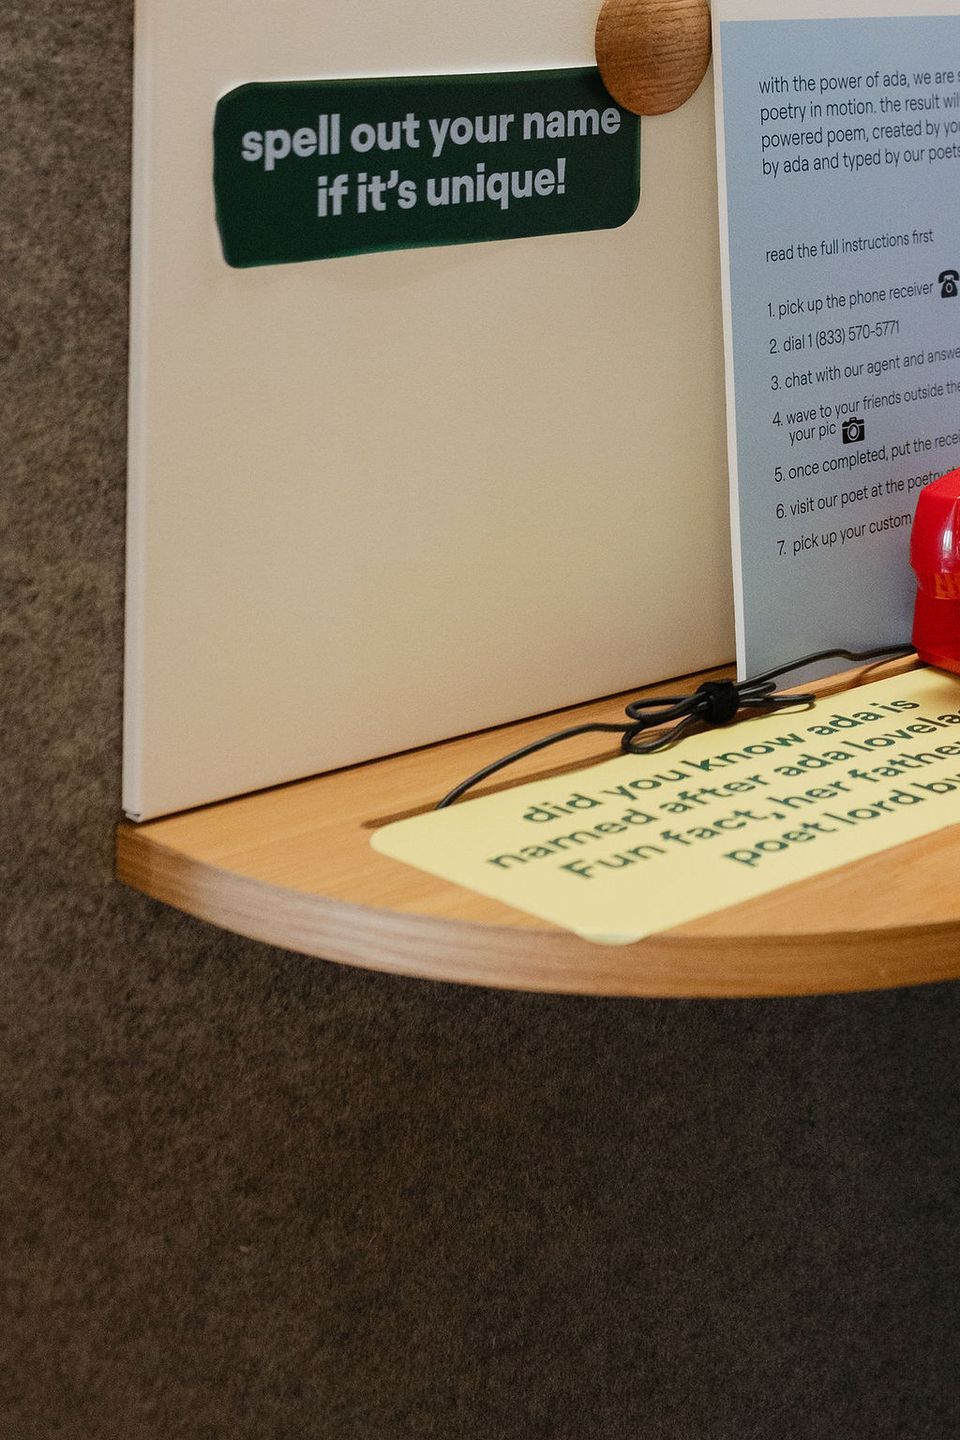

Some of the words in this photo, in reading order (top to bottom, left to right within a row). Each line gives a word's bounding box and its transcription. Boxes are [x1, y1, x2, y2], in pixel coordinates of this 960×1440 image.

[759, 76, 788, 93] with
[793, 75, 816, 92] the
[820, 76, 862, 94] power
[866, 71, 879, 88] of
[883, 70, 910, 88] ada,
[913, 72, 931, 85] we
[935, 71, 955, 84] are
[760, 103, 806, 125] poetry
[810, 101, 822, 117] in
[880, 97, 901, 113] the
[905, 93, 941, 111] result
[241, 114, 341, 171] spell
[351, 113, 420, 153] out
[429, 114, 514, 157] your
[523, 107, 621, 140] name
[761, 127, 823, 152] powered
[827, 128, 869, 147] poem,
[872, 120, 922, 140] created
[926, 120, 940, 138] by
[763, 158, 779, 178] by
[783, 155, 809, 173] ada
[813, 152, 839, 171] and
[842, 148, 881, 172] typed
[885, 148, 900, 168] by
[903, 148, 925, 162] our
[317, 174, 349, 217] if
[357, 169, 417, 213] it's
[426, 157, 567, 210] unique!
[766, 245, 794, 262] read
[797, 244, 818, 259] the
[820, 240, 839, 255] full
[842, 232, 910, 253] instructions
[912, 229, 934, 245] first
[767, 303, 775, 318] 1.
[778, 299, 804, 320] pick
[807, 298, 823, 315] up
[826, 294, 847, 308] the
[849, 288, 886, 310] phone
[889, 282, 935, 300] receiver
[769, 338, 780, 355] 2.
[783, 334, 806, 353] dial
[815, 328, 846, 349] (833)
[848, 320, 900, 343] 570-5771
[771, 375, 782, 391] 3.
[784, 370, 813, 389] chat
[815, 365, 841, 383] with
[844, 363, 865, 378] our
[867, 356, 901, 377] agent
[903, 351, 925, 368] and
[772, 412, 784, 427] 4.
[786, 408, 818, 425] wave
[819, 404, 832, 418] to
[834, 400, 861, 419] your
[862, 390, 902, 411] friends
[903, 383, 945, 403] outside
[789, 426, 816, 446] your
[818, 421, 838, 441] pic
[774, 466, 786, 483] 5.
[788, 462, 820, 480] once
[822, 446, 889, 473] completed,
[891, 441, 912, 462] put
[913, 439, 933, 454] the
[776, 503, 788, 520] 6.
[789, 498, 816, 516] visit
[817, 494, 839, 510] our
[841, 487, 869, 509] poet
[871, 483, 884, 498] at
[886, 479, 906, 495] the
[777, 540, 787, 557] 7.
[793, 533, 820, 557] pick
[821, 530, 838, 548] up
[840, 523, 867, 545] your
[868, 513, 913, 534] custom
[521, 791, 604, 824] did
[602, 768, 693, 801] you
[680, 731, 805, 773] know
[806, 710, 885, 736] ada
[871, 700, 920, 713] is
[487, 808, 660, 869] named
[659, 773, 770, 813] after
[773, 750, 856, 777] ada
[559, 843, 667, 879] Fun
[660, 808, 786, 847] fact,
[767, 780, 853, 809] her
[724, 821, 839, 867] poet
[822, 788, 926, 825] lord
